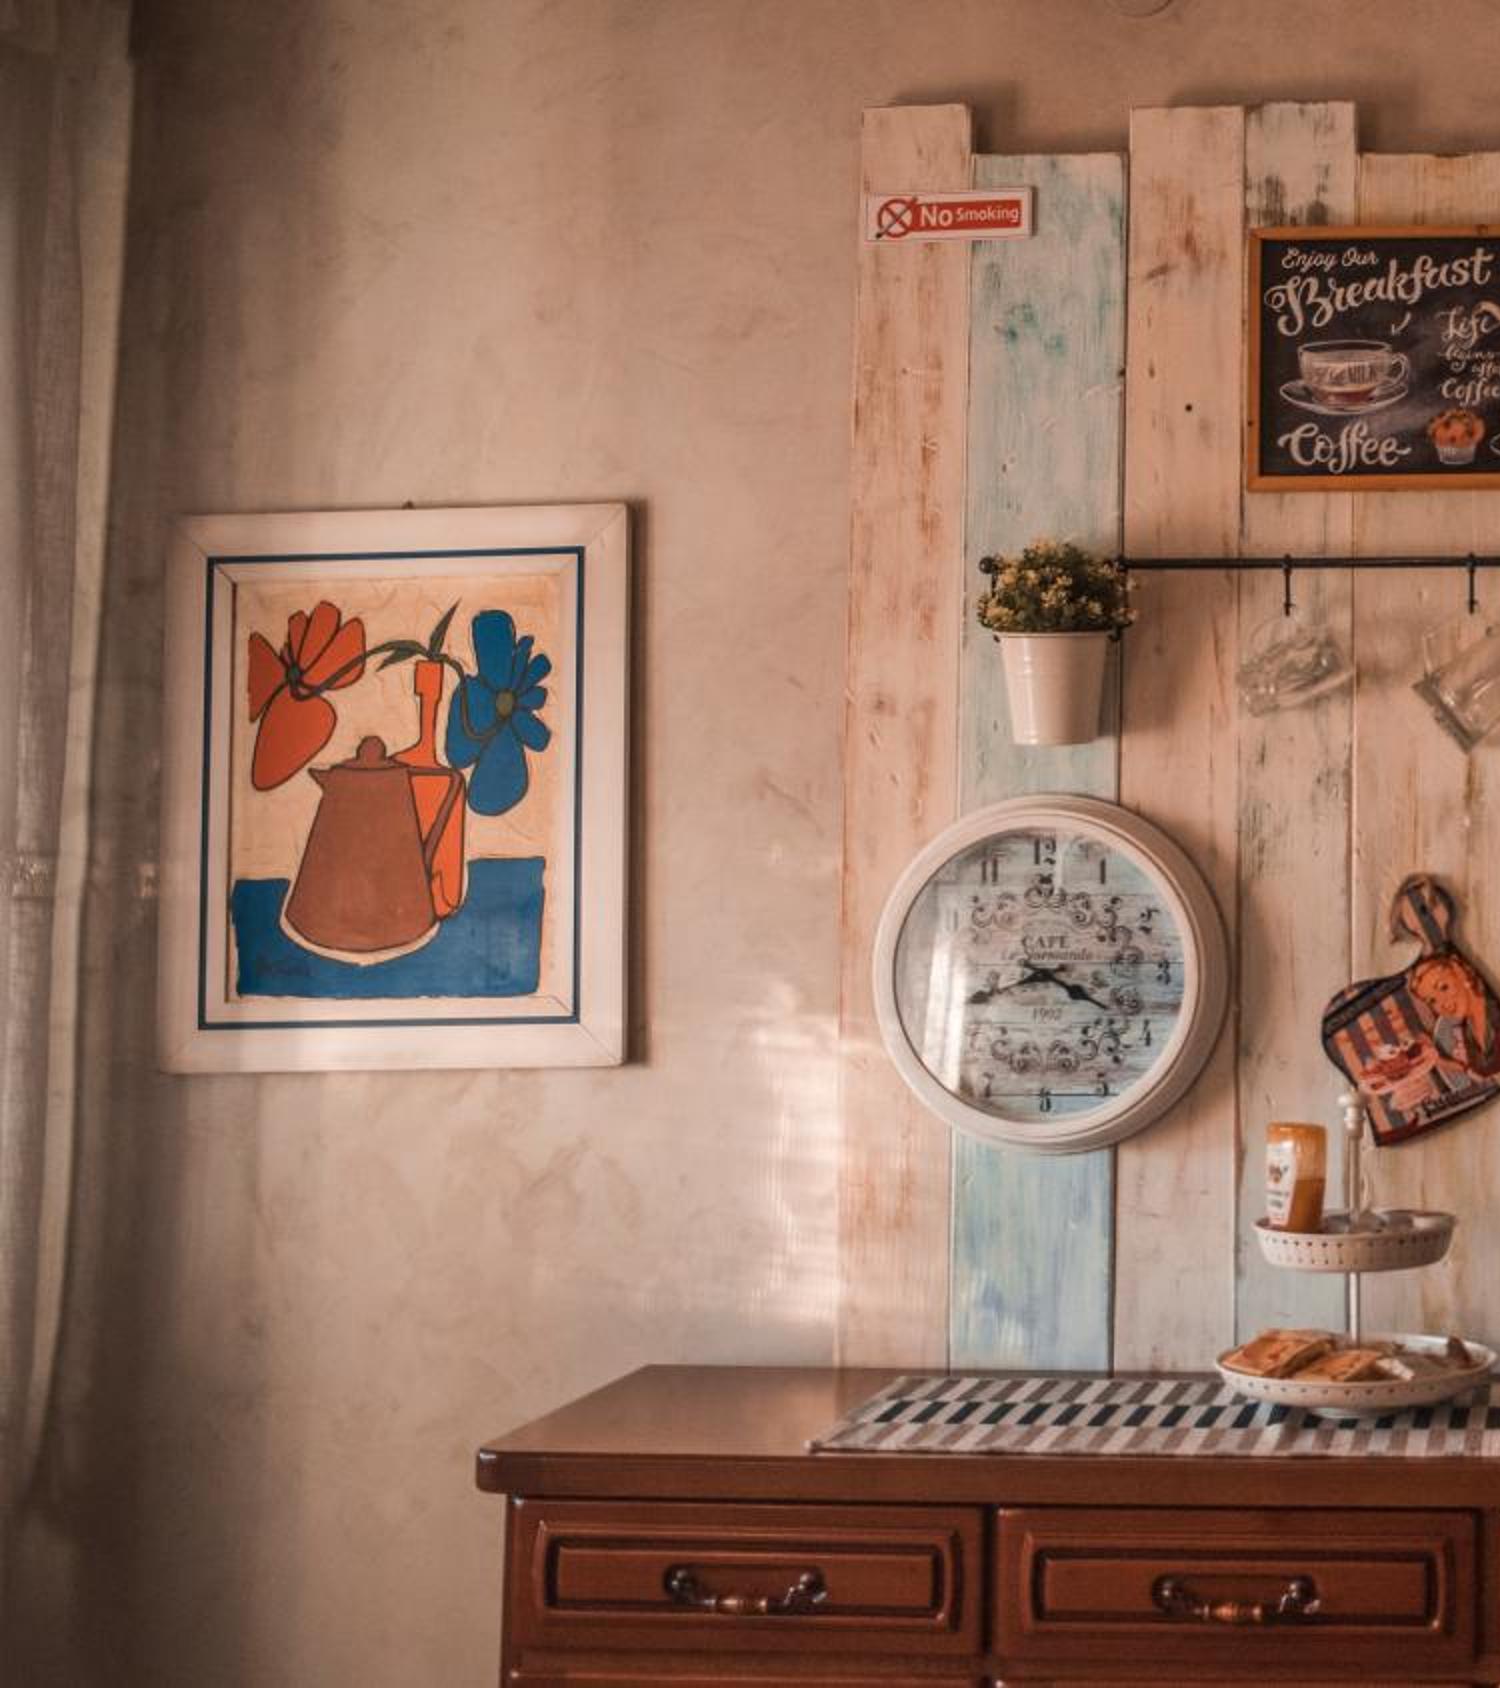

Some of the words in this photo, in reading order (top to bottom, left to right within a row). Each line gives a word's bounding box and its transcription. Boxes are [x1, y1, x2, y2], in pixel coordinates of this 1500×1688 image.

[920, 206, 953, 226] No
[957, 206, 1019, 222] Smoking
[1281, 247, 1338, 272] Enjoy
[1341, 247, 1379, 267] Our
[1264, 247, 1494, 336] Breakfast
[1277, 422, 1412, 474] Coffee
[1033, 838, 1057, 865] 12
[981, 857, 998, 886] 11
[1100, 859, 1106, 885] 1
